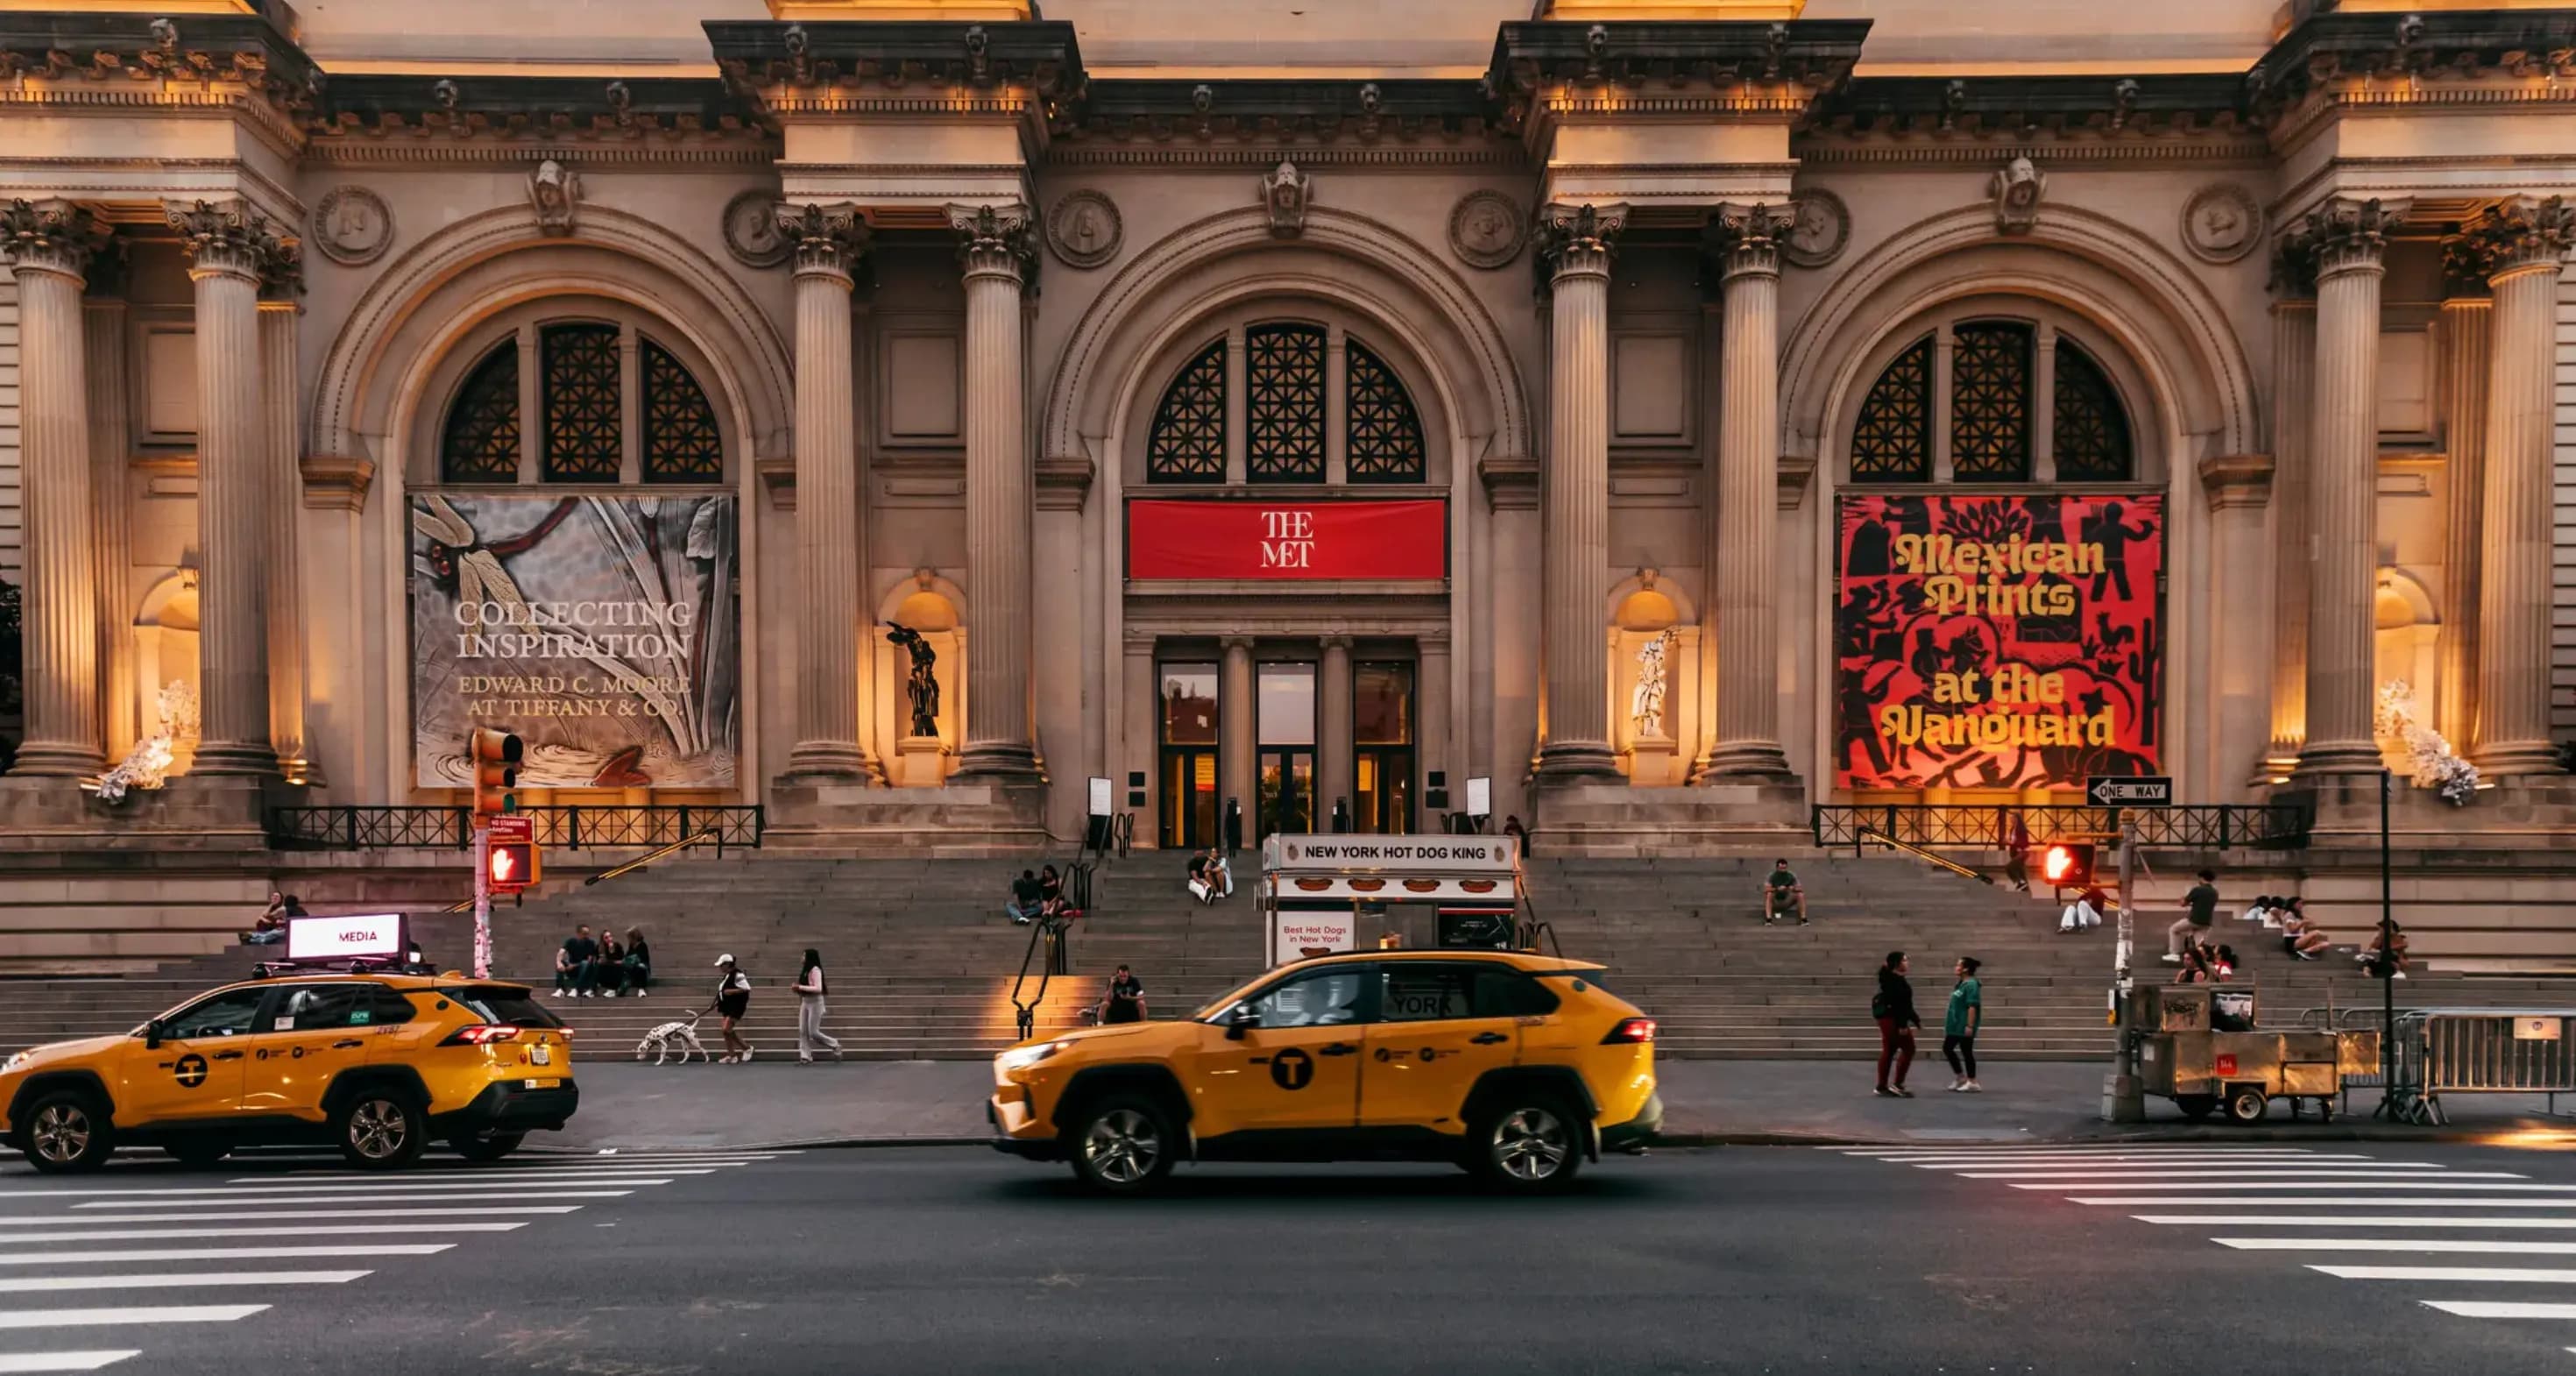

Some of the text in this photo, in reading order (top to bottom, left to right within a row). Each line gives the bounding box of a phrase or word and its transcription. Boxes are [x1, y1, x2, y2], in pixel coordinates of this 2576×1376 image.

[1261, 512, 1313, 538] THE
[1260, 541, 1315, 568] MET
[1894, 534, 2105, 575] Mexican
[1923, 575, 2076, 616] Prints
[454, 601, 691, 627] COLLECTING
[456, 635, 691, 658] INSPIRATION
[458, 677, 691, 693] EDWARD C. MOORE
[1933, 663, 2064, 704] at the
[468, 700, 683, 716] AT TIFFANY & CO.
[1879, 706, 2115, 753] Vanguard
[2100, 786, 2161, 798] ONE WAY
[1306, 846, 1486, 860] NEW YORK HOT DOG KING
[339, 931, 378, 942] MEDIA
[1324, 926, 1347, 935] Dogs
[1394, 996, 1452, 1014] YORK
[182, 1060, 200, 1083] T
[1281, 1057, 1304, 1084] T
